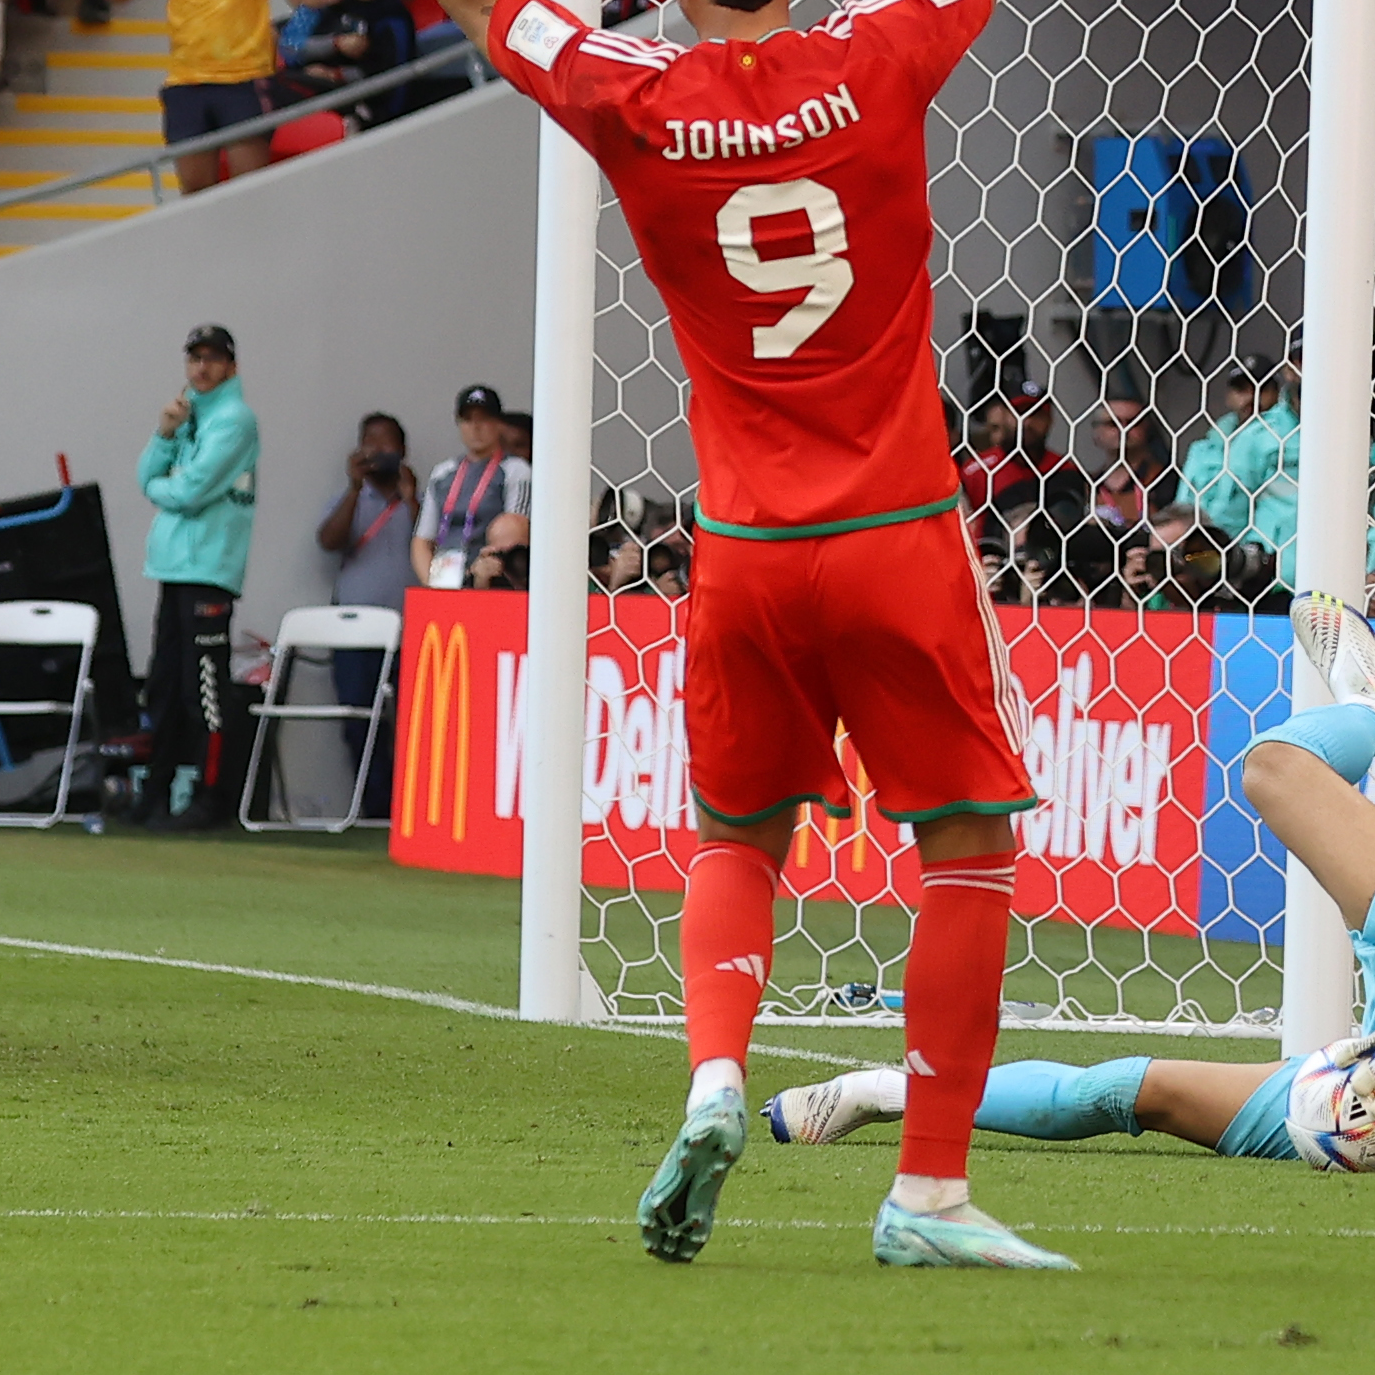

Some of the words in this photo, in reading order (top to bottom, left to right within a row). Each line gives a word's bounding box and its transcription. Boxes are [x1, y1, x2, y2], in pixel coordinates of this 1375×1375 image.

[661, 82, 862, 161] JOHNSON
[715, 177, 856, 360] 9
[581, 651, 699, 832] Deli
[1011, 650, 1172, 866] eliver
